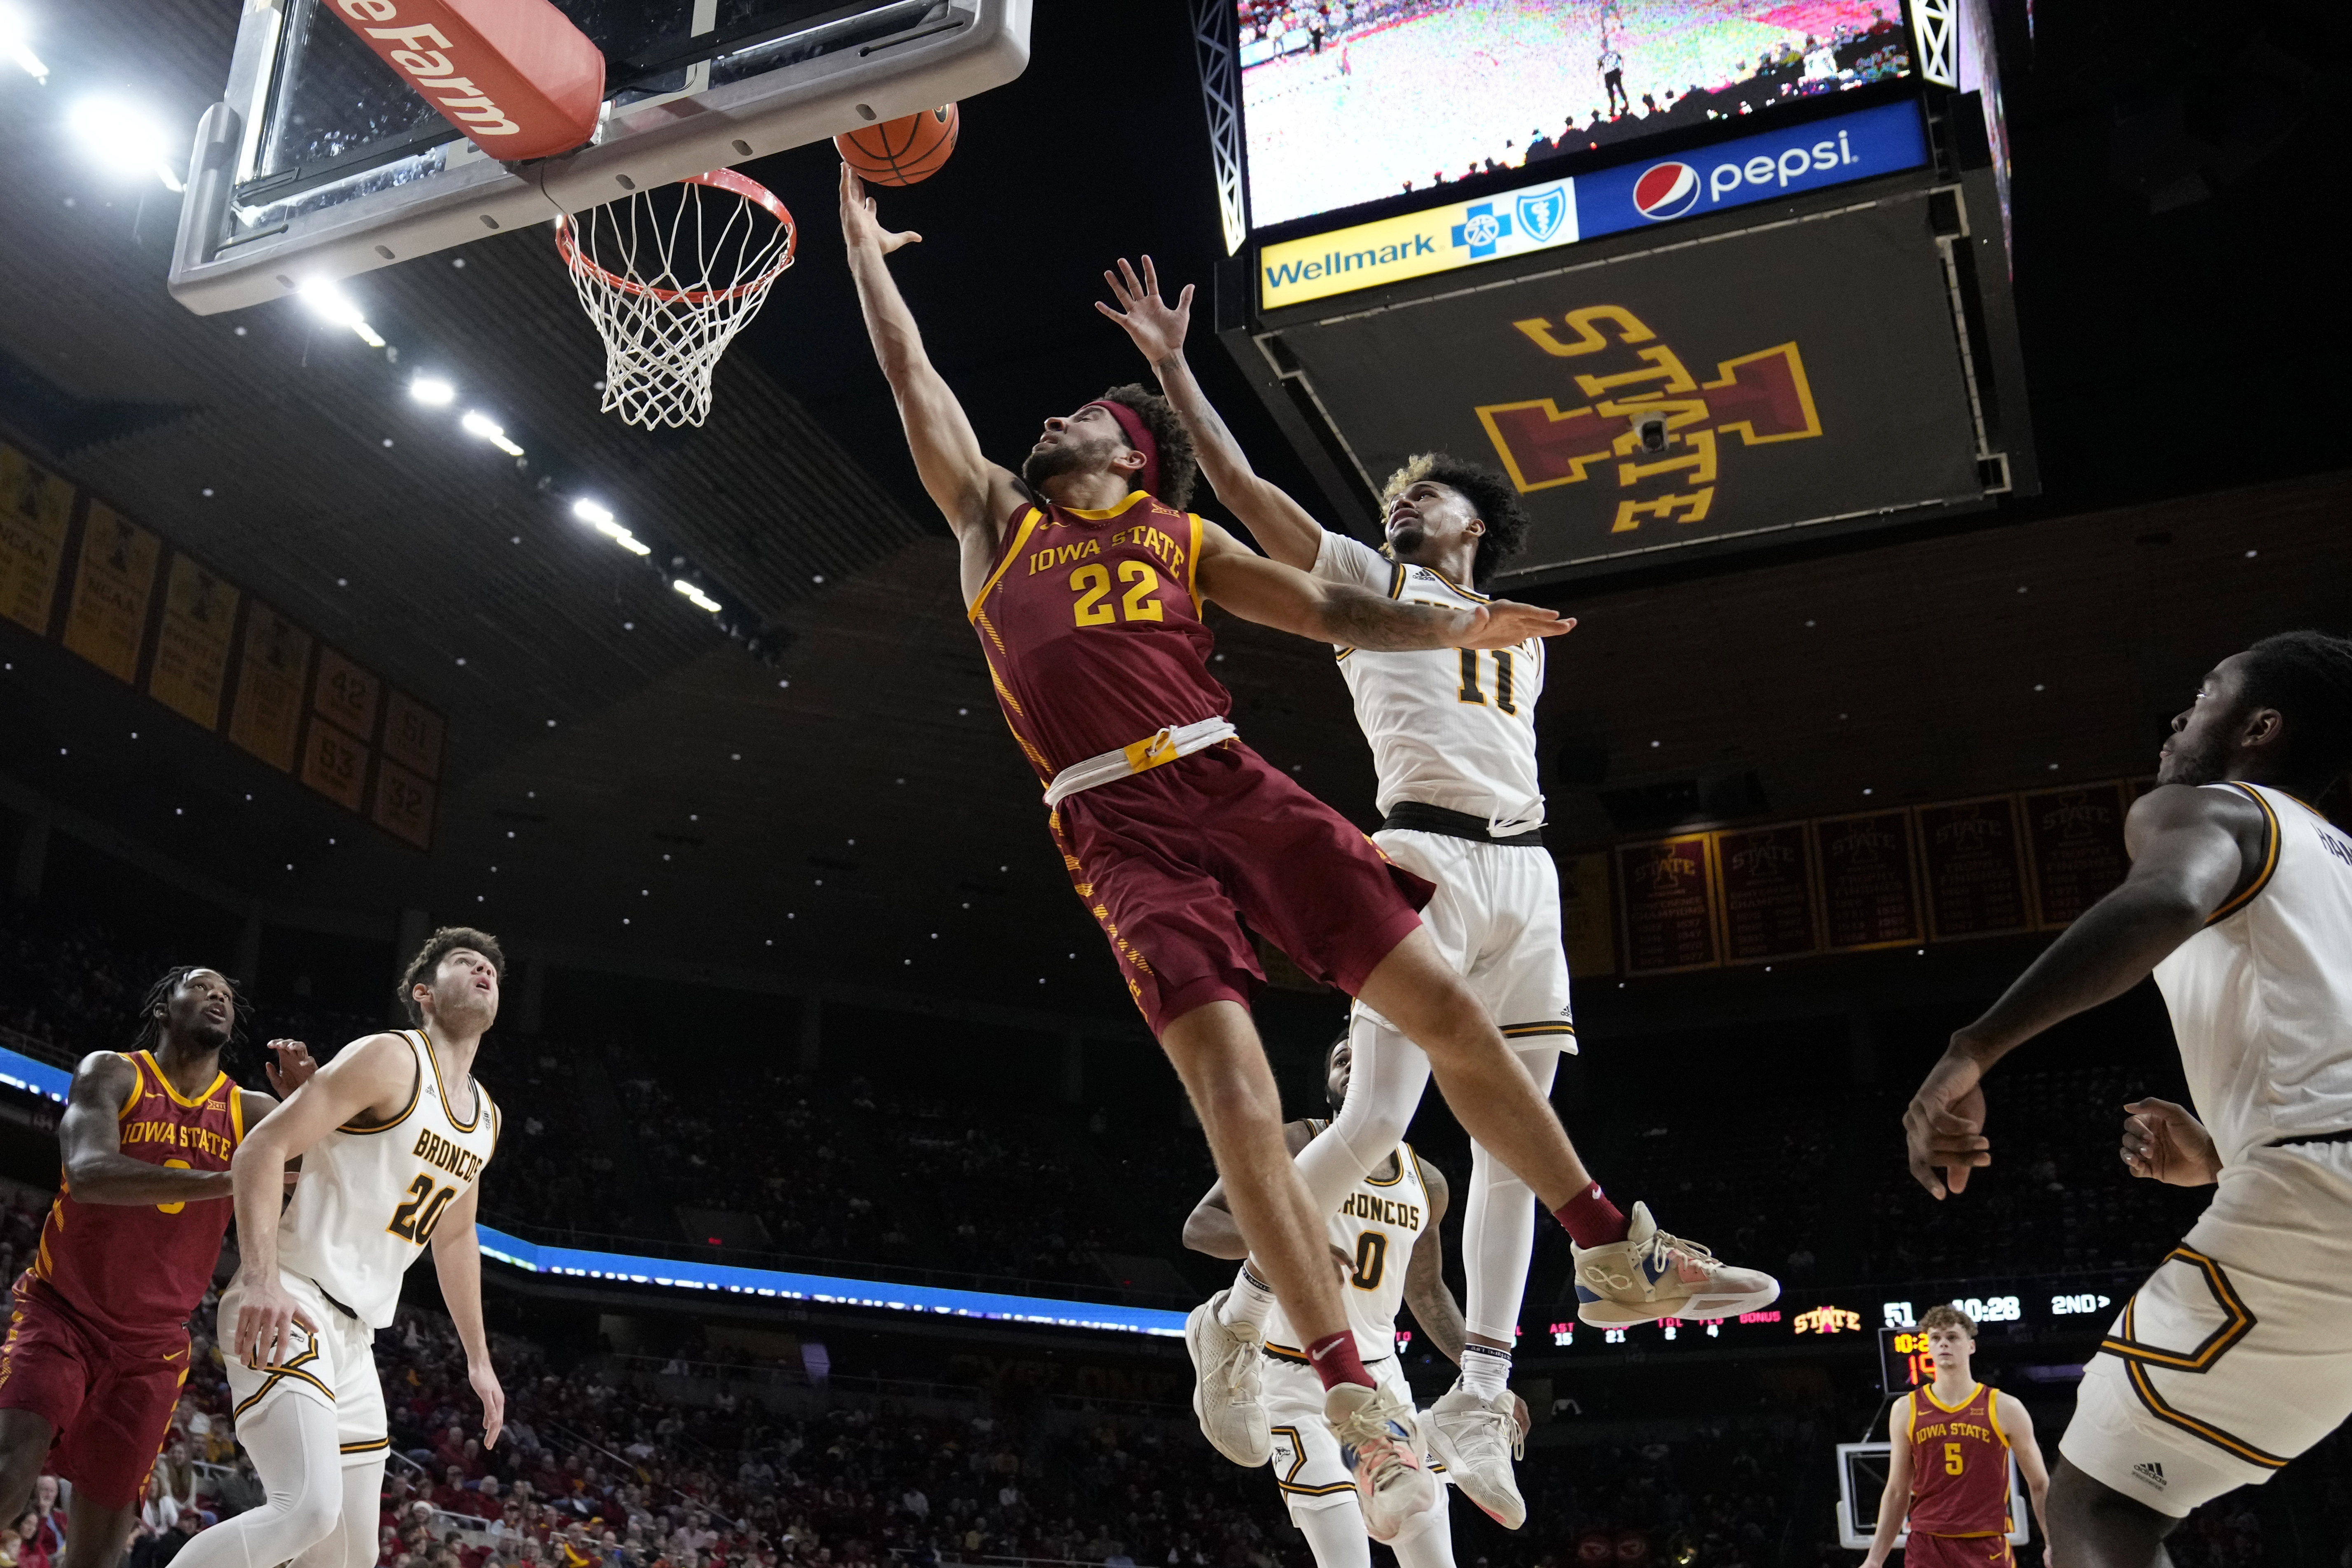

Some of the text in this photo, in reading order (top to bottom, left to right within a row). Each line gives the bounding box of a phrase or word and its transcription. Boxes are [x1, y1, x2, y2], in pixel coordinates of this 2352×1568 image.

[364, 23, 520, 135] Farm
[1710, 130, 1851, 202] pepsi
[1266, 234, 1436, 288] Wellmark
[1512, 305, 1717, 533] STATE
[1028, 525, 1184, 578] IOWA STATE
[1069, 560, 1164, 627] 22
[1455, 647, 1518, 717] 11
[122, 1121, 231, 1161] IOWA STATE
[413, 1128, 483, 1183] BRONCOS
[386, 1172, 457, 1247] 20
[1338, 1192, 1419, 1231] RONCOS
[1350, 1229, 1388, 1292] 0
[1549, 1322, 1575, 1334] AST
[1739, 1311, 1781, 1324] BONUS
[1794, 1308, 1861, 1334] STATE
[1883, 1301, 1917, 1328] 51
[1555, 1332, 1573, 1346] 15
[1605, 1330, 1626, 1343] 21
[1665, 1326, 1677, 1340] 2
[1706, 1324, 1719, 1338] 4
[1894, 1333, 1930, 1353] 10:2
[1397, 1341, 1409, 1354] 7
[1916, 1423, 1991, 1444] IOWA STATE
[1944, 1443, 1964, 1475] 5
[2134, 1465, 2166, 1485] adidas
